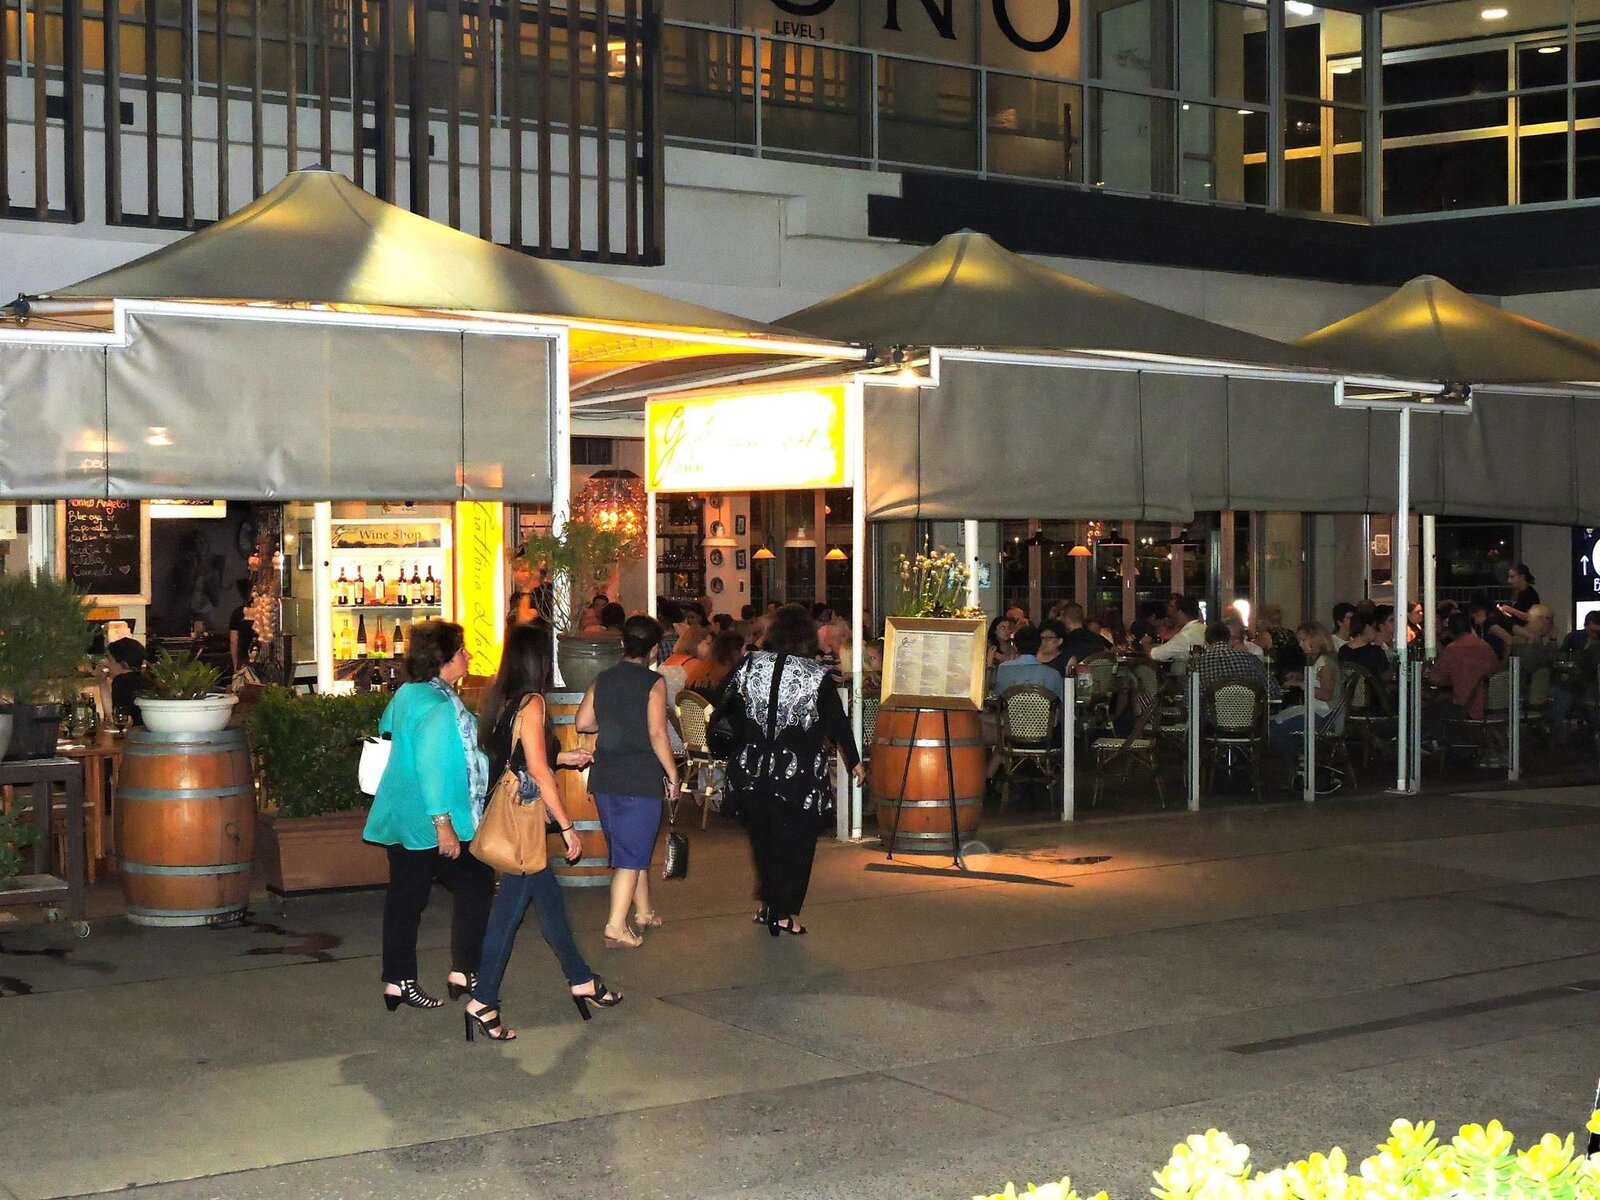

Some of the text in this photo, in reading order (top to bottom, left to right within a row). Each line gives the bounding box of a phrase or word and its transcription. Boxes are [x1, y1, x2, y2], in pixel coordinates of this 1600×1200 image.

[775, 20, 825, 40] LEVEL 1
[359, 530, 389, 540] Wine
[393, 529, 422, 541] Shop
